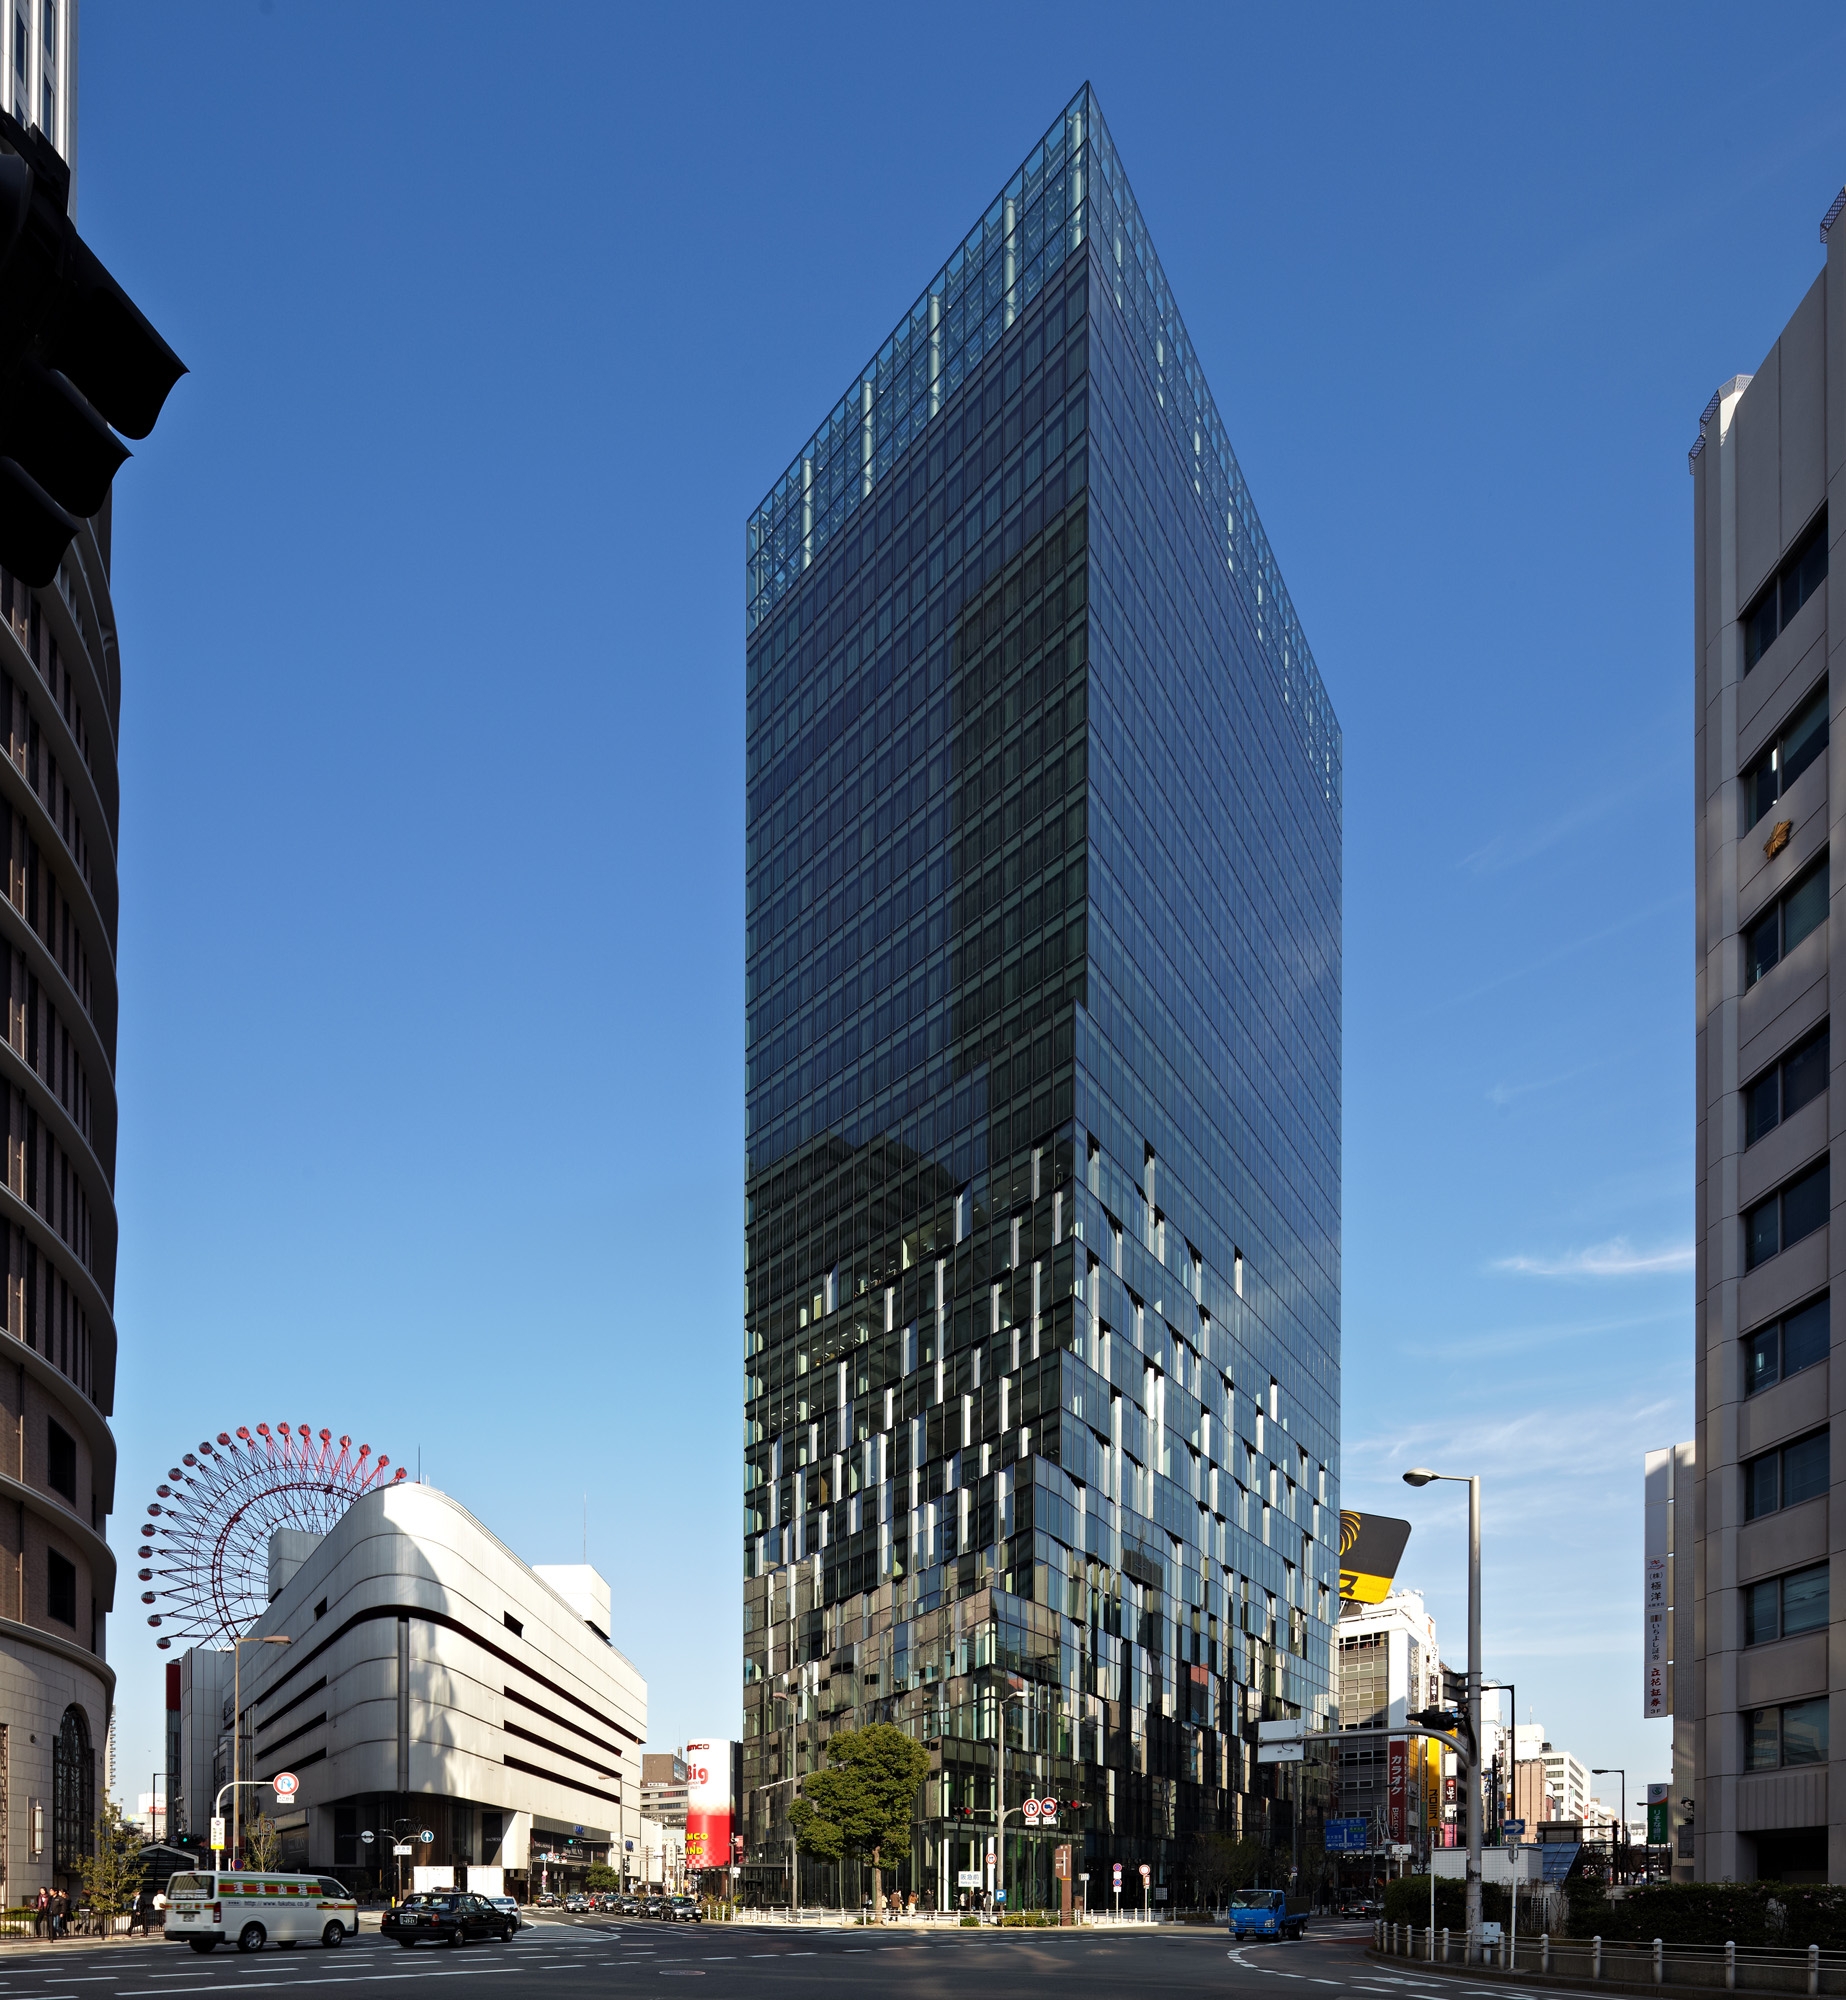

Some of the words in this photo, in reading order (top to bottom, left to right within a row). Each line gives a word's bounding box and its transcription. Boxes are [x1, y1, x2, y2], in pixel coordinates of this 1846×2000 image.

[1651, 1622, 1661, 1661] いちよし証券
[1650, 1667, 1662, 1707] 立花証券
[687, 1763, 709, 1785] Big
[1391, 1755, 1403, 1796] カラオケ
[1652, 1809, 1662, 1841] りそな銀行
[960, 1873, 980, 1881] 阪急前
[997, 1891, 1005, 1901] P
